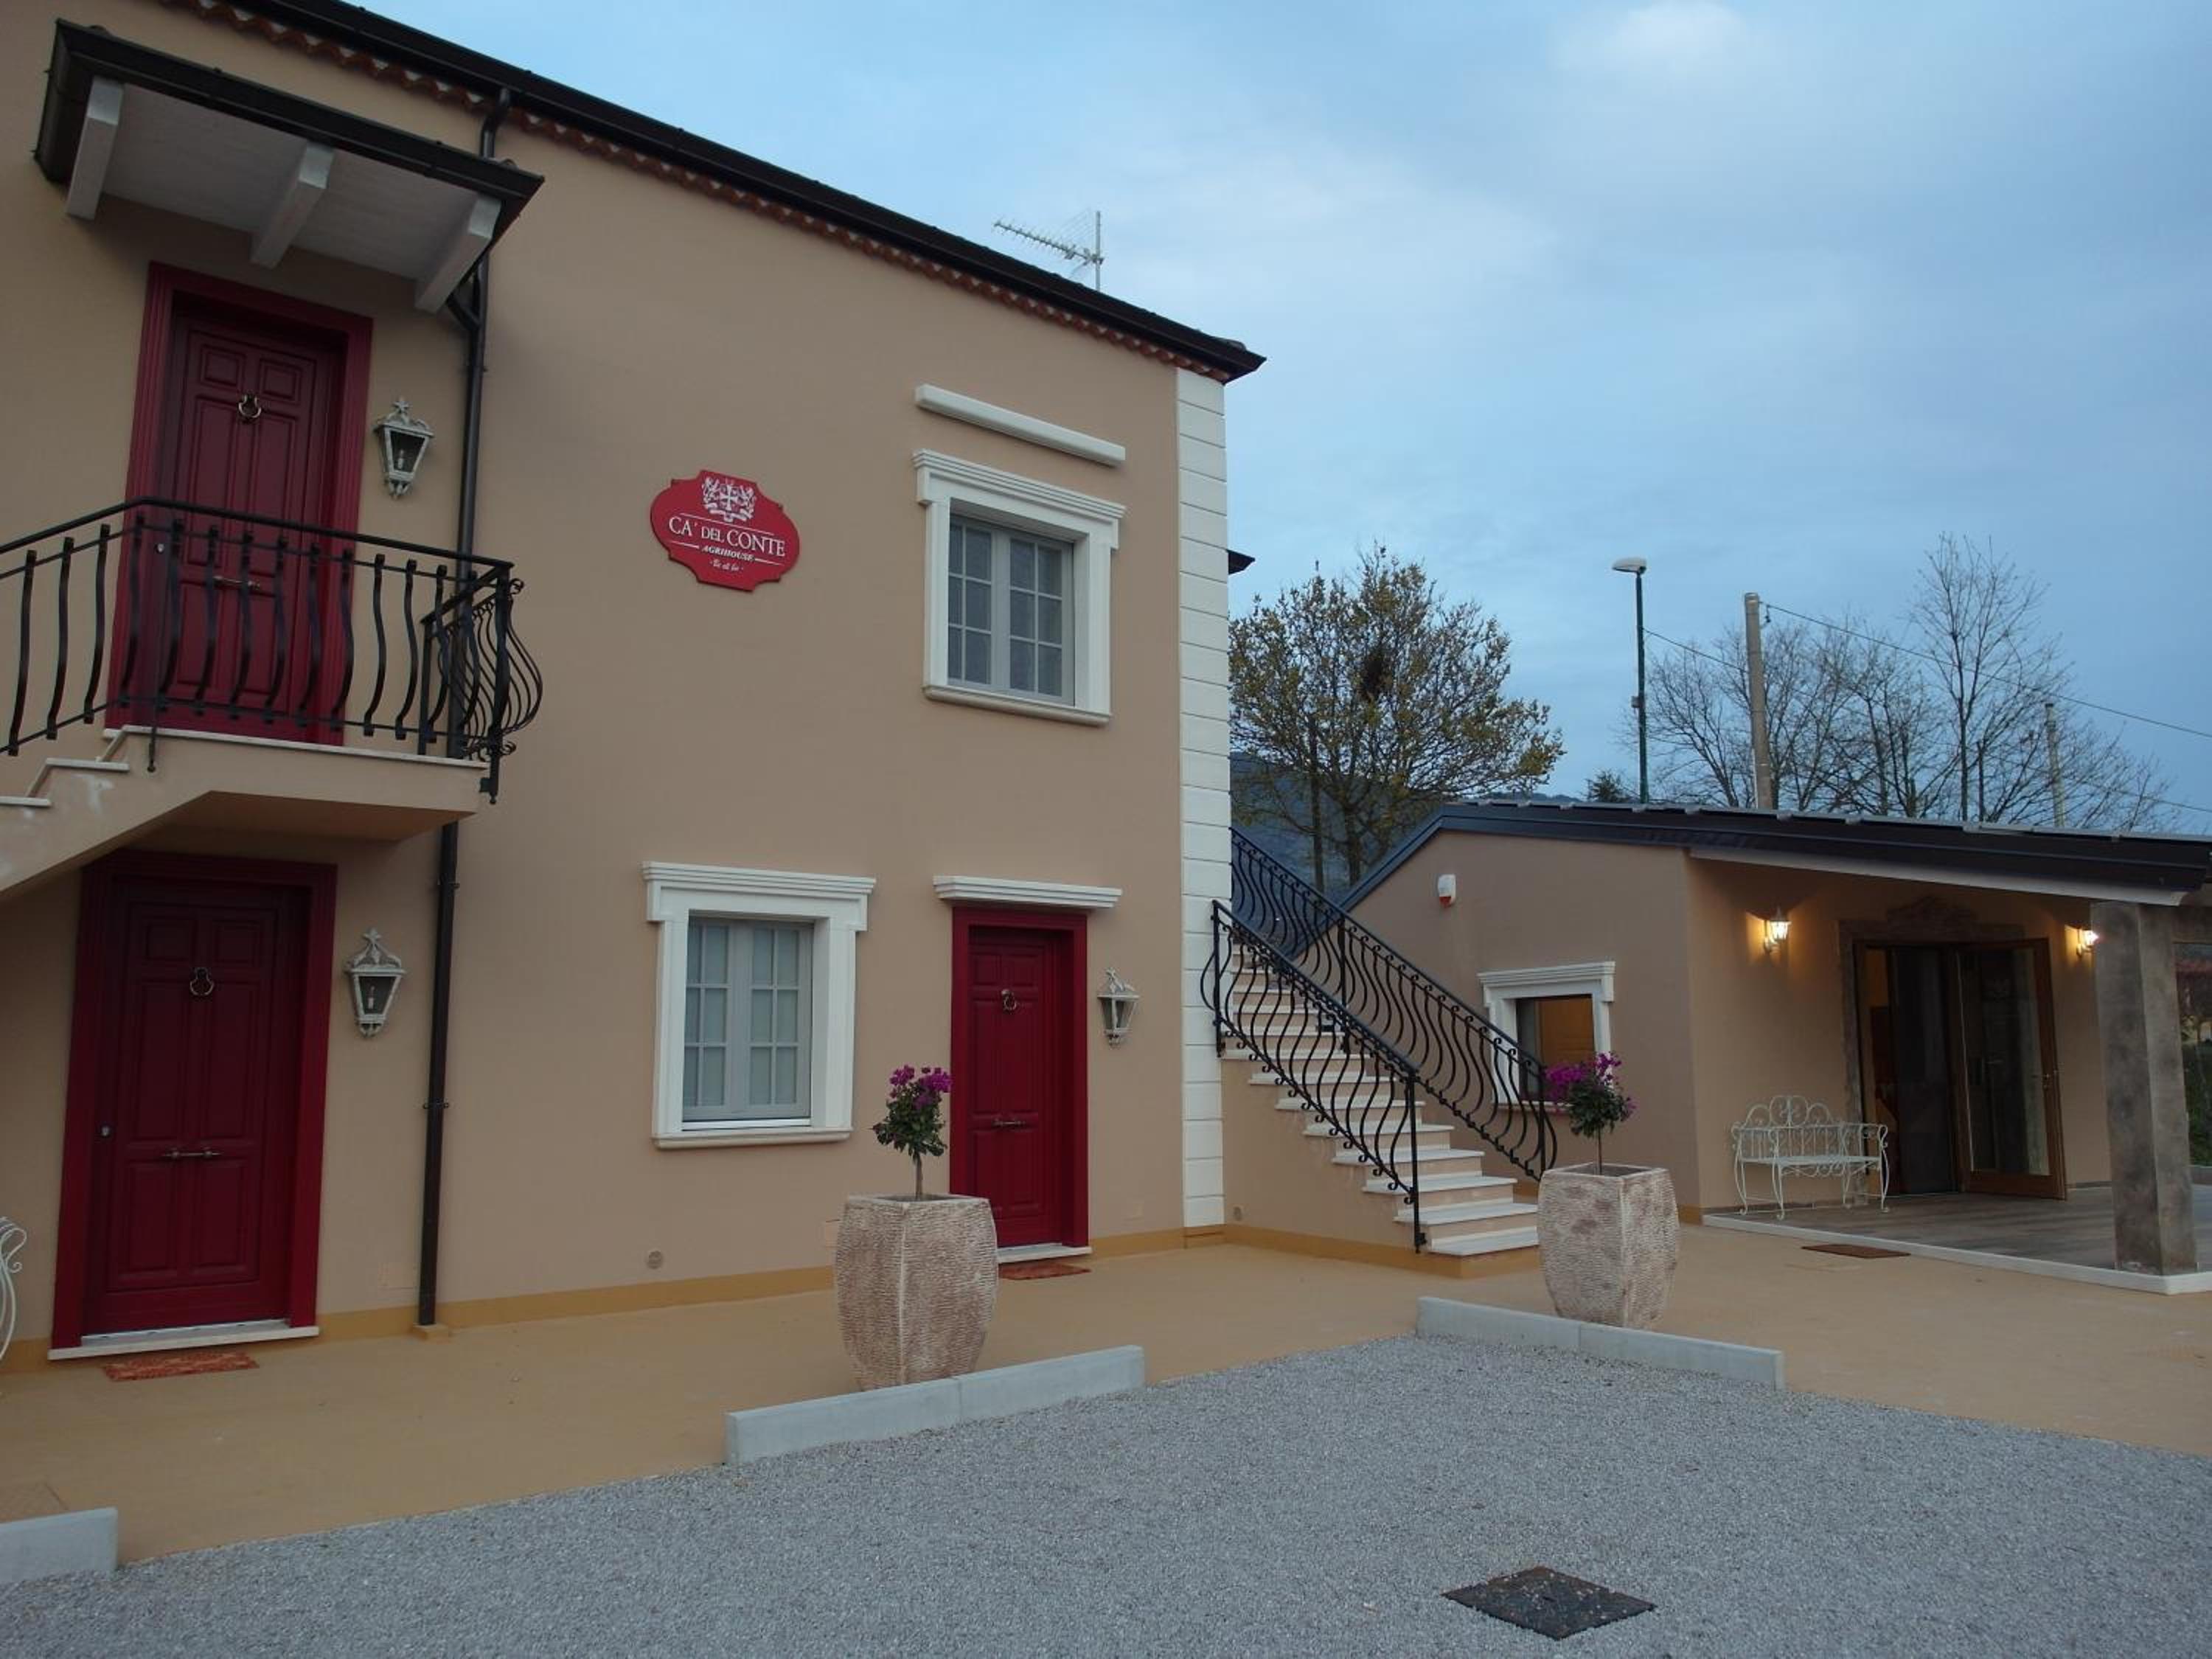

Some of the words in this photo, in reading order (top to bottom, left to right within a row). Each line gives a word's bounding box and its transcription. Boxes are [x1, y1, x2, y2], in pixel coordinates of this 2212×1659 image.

[701, 526, 725, 543] DEL
[726, 529, 785, 557] CONTE
[703, 545, 755, 562] AGRIHOUSE
